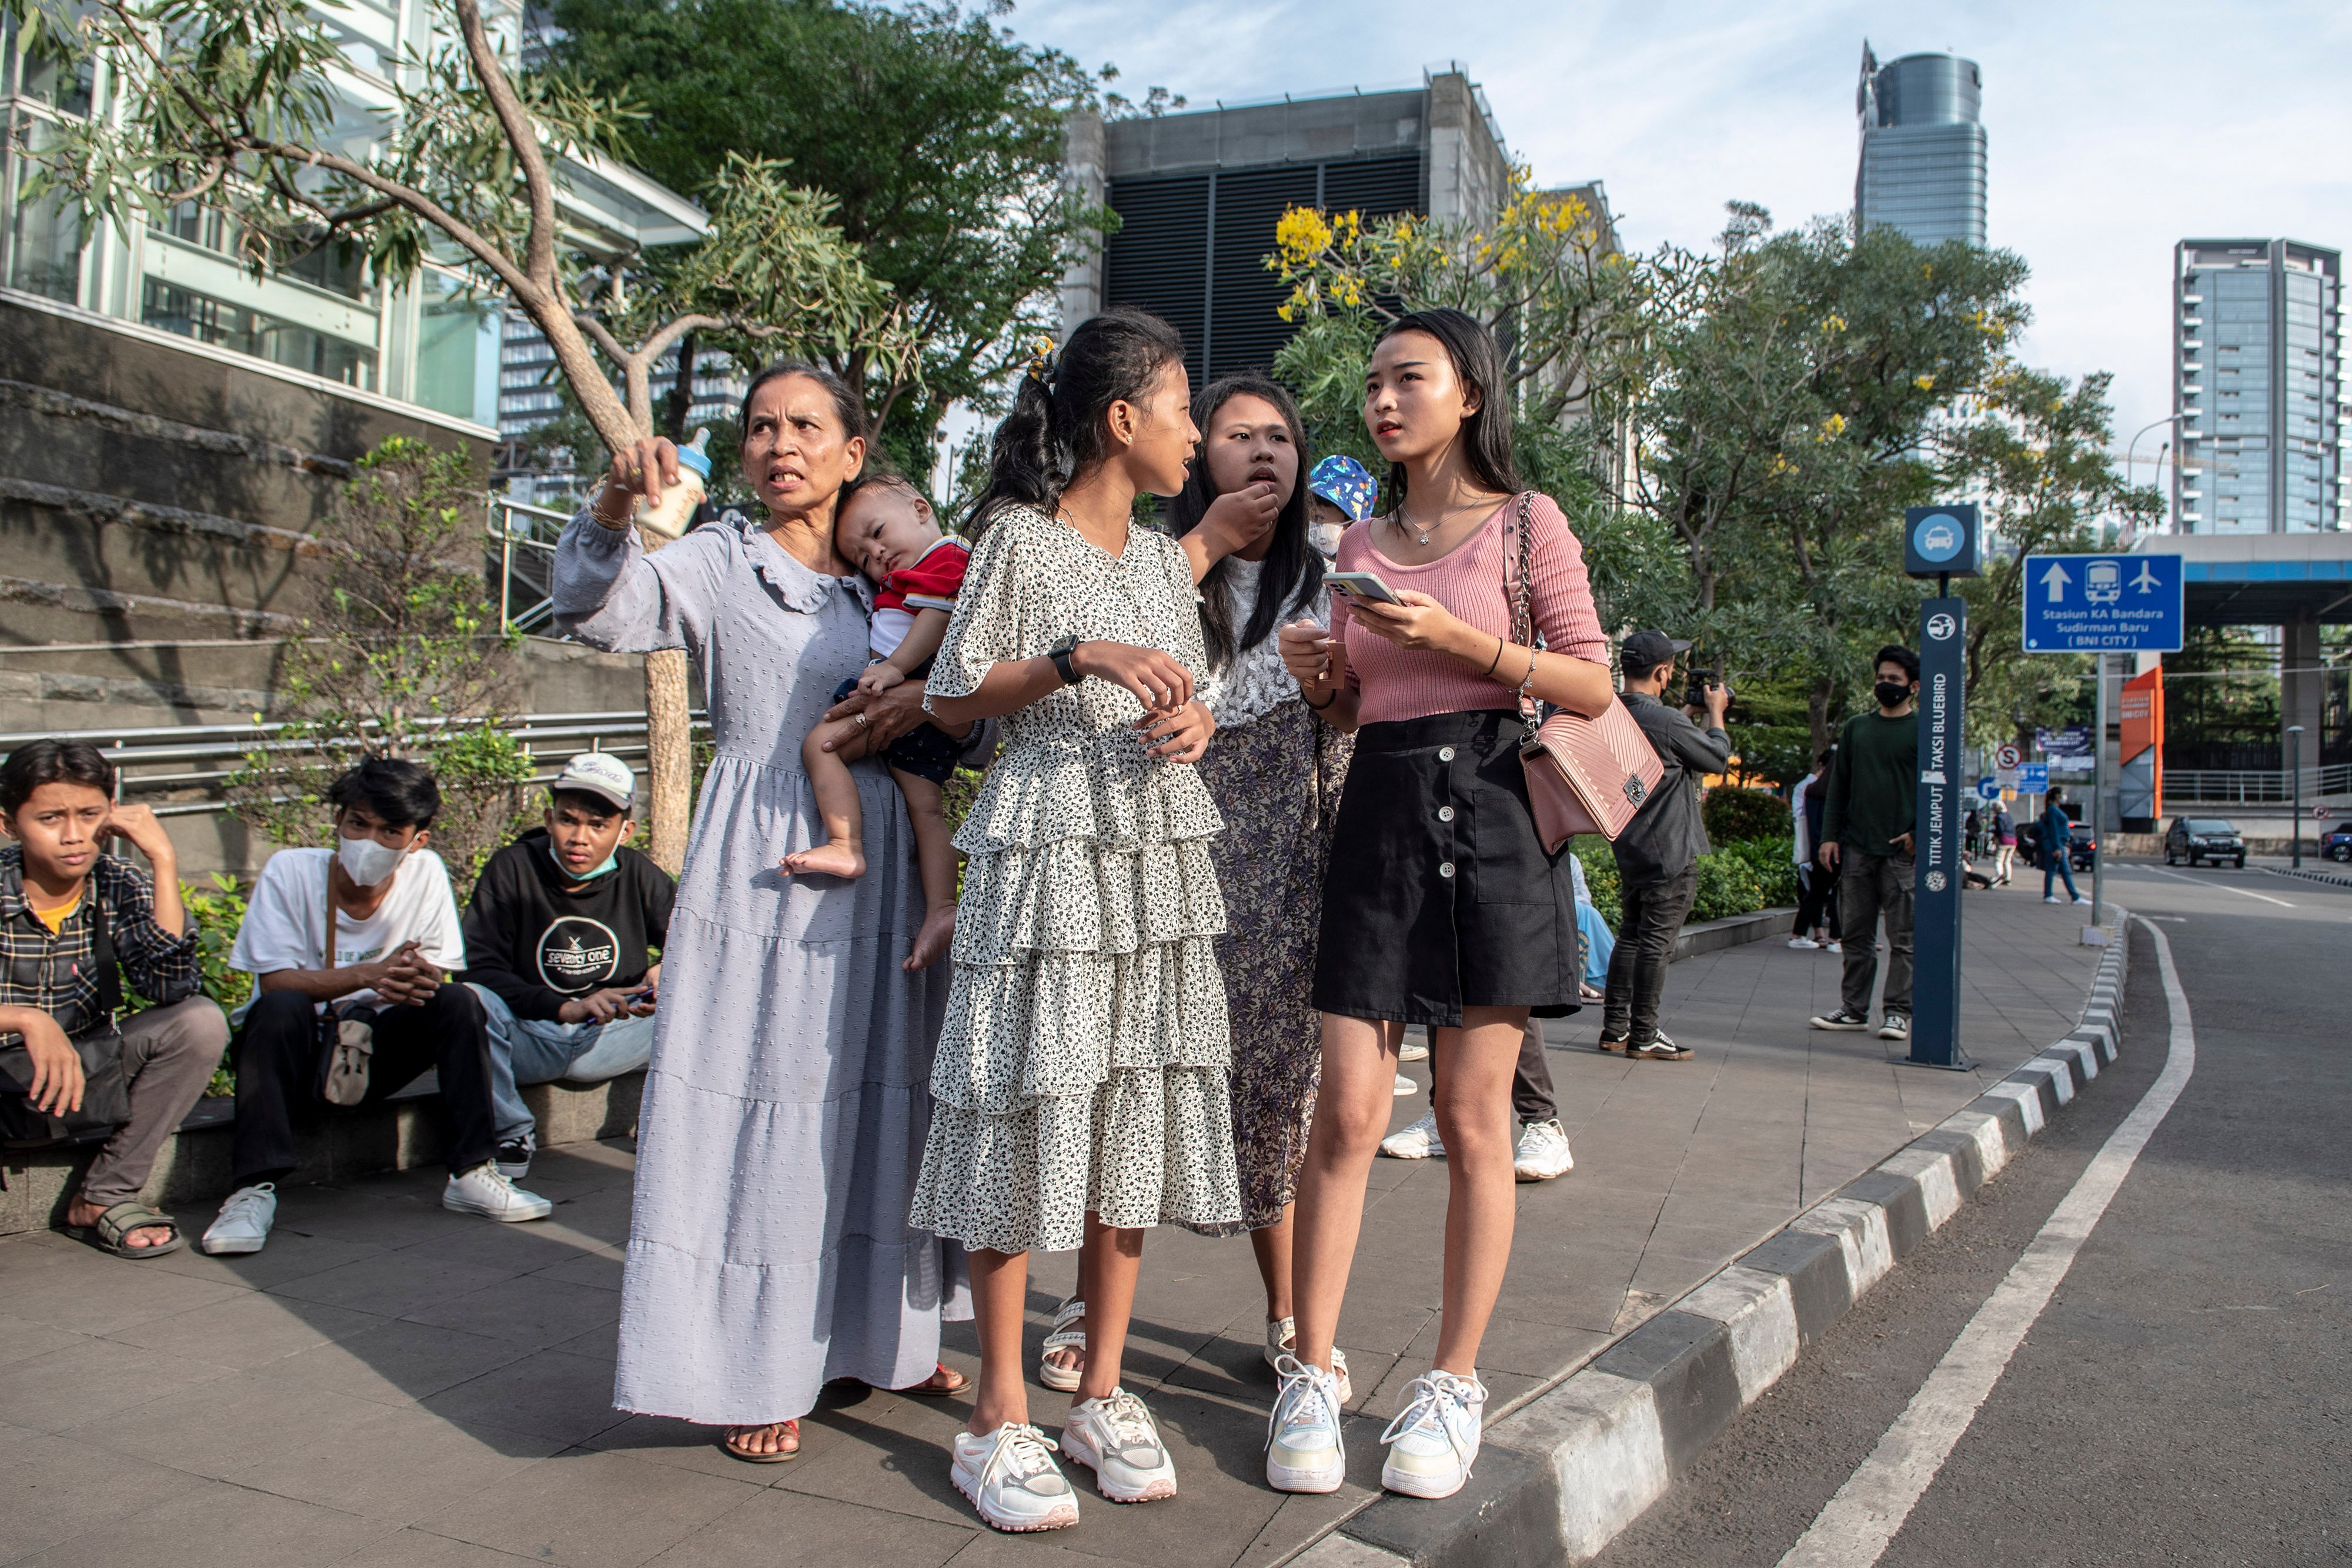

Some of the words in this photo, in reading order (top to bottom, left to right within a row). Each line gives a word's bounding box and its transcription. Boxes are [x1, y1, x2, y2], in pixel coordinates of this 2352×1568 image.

[2043, 609, 2087, 619] Stasiun
[2091, 610, 2108, 618] KA
[2112, 608, 2163, 619] Bandara
[2056, 622, 2116, 633] Sudirman
[2120, 623, 2149, 632] Baru
[1932, 673, 1946, 733] BLUEBIRD
[1931, 735, 1945, 770] TAKSI
[2003, 750, 2014, 764] S
[1930, 785, 1943, 834] JEMPUT
[1929, 837, 1942, 866] TITIK
[547, 952, 586, 964] seventy
[588, 950, 610, 962] one
